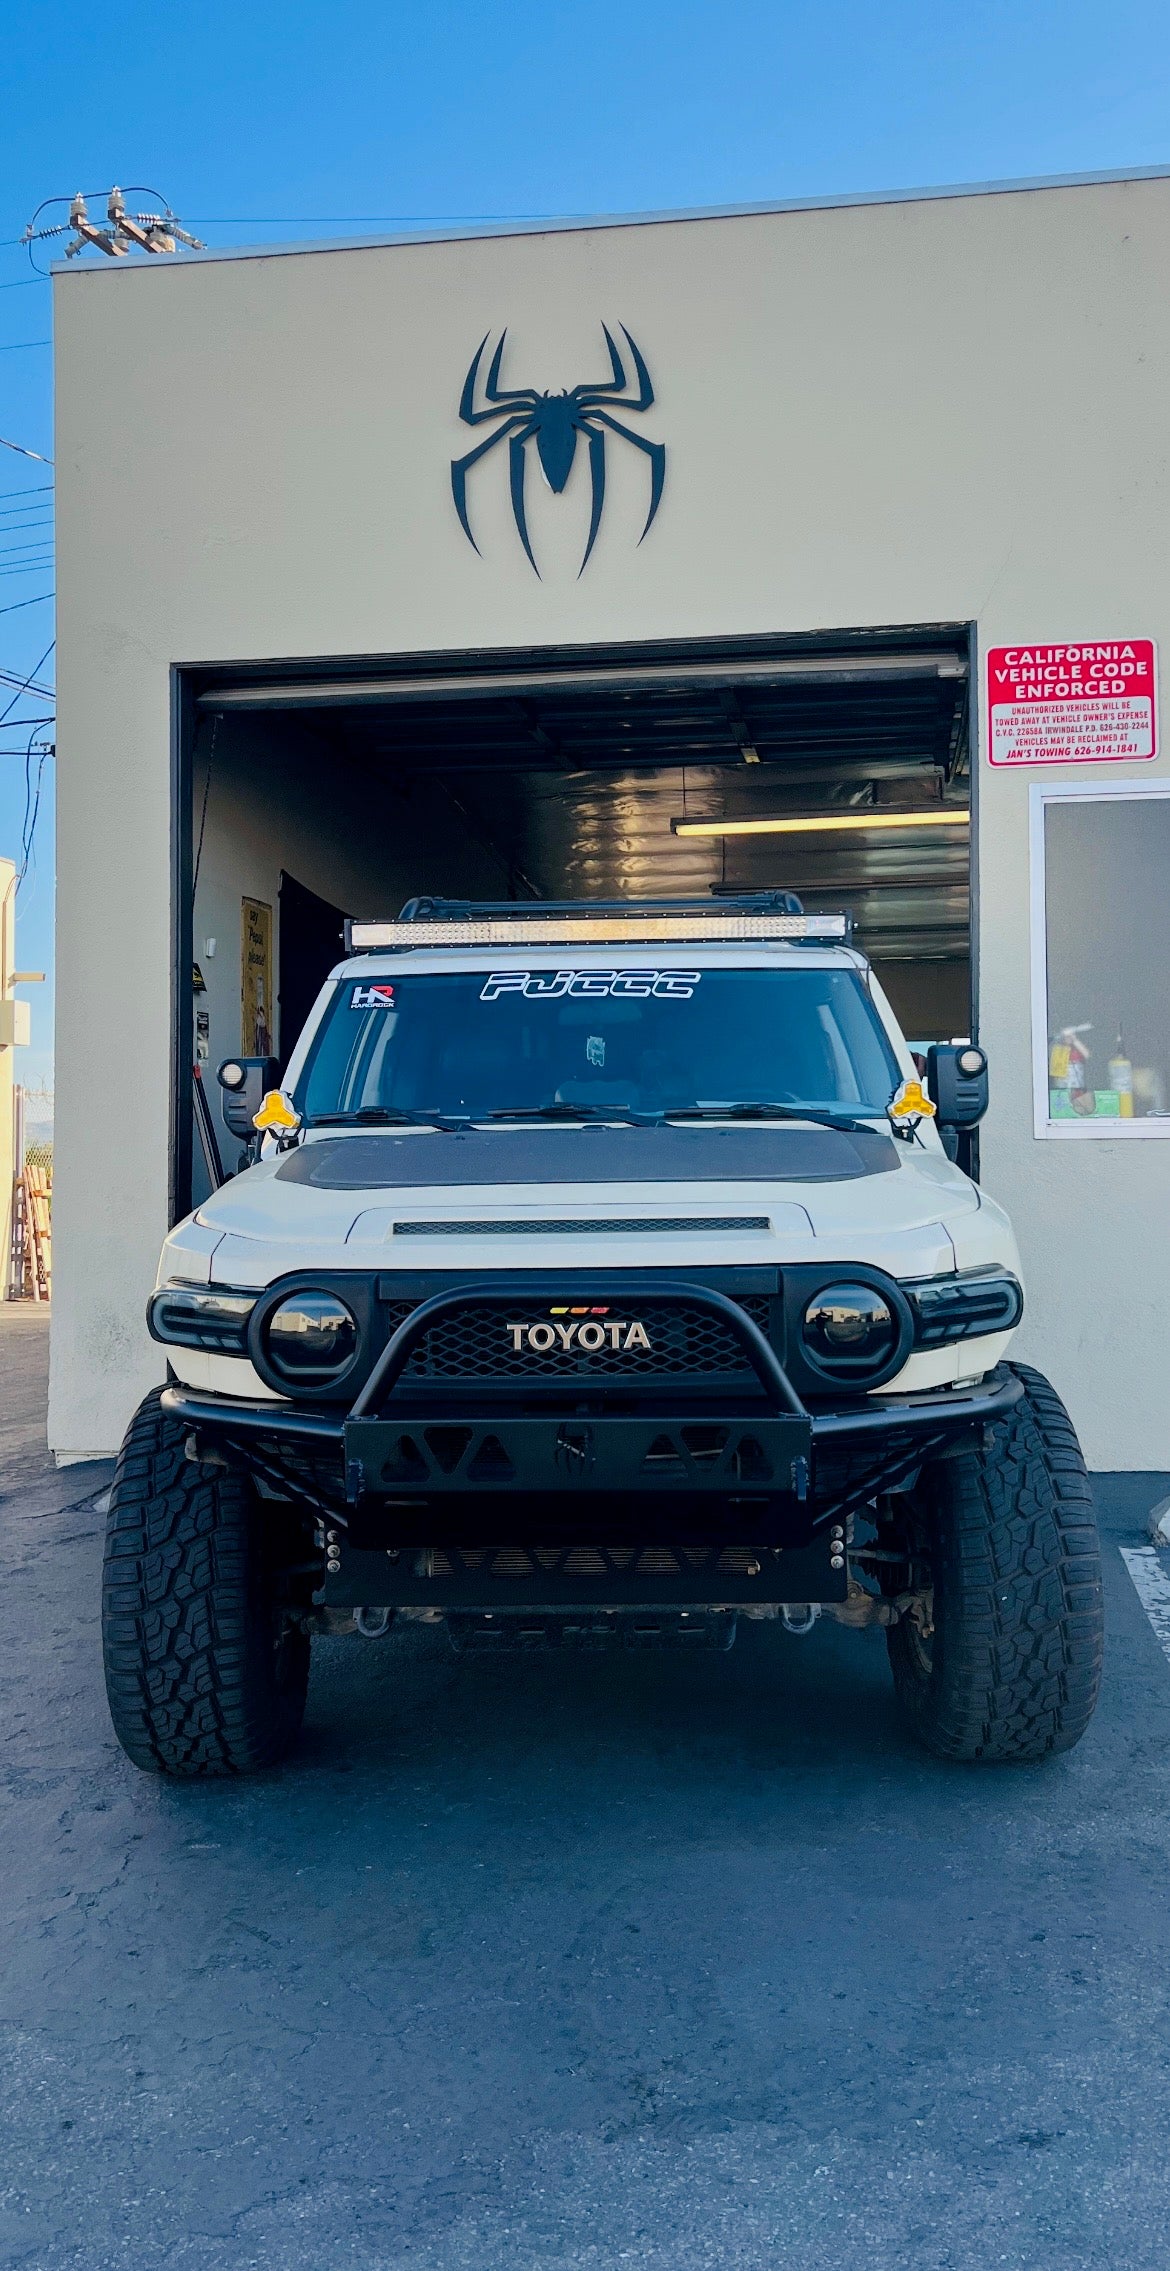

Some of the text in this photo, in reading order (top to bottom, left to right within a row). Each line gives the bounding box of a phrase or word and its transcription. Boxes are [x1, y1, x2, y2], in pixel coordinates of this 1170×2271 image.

[1004, 645, 1136, 666] CALIFORNIA
[995, 661, 1148, 683] VEHICLE CODE
[1015, 680, 1126, 699] ENFORCED
[1012, 701, 1131, 715] UNAUTHORIZED VEHICLES WILL BE
[995, 711, 1149, 726] TOWED AWAY AT VEHICLE OWNER'S EXPENSE
[1045, 725, 1084, 735] IRWINDALE
[1085, 724, 1098, 733] P.D.
[1099, 722, 1149, 732] 626-430-2244
[1015, 733, 1128, 746] VEHICLES MAY BE RECLAIMED AT
[1006, 744, 1138, 759] JAN'S TOWING 626-914-1841
[506, 1322, 651, 1350] TOYOTA
